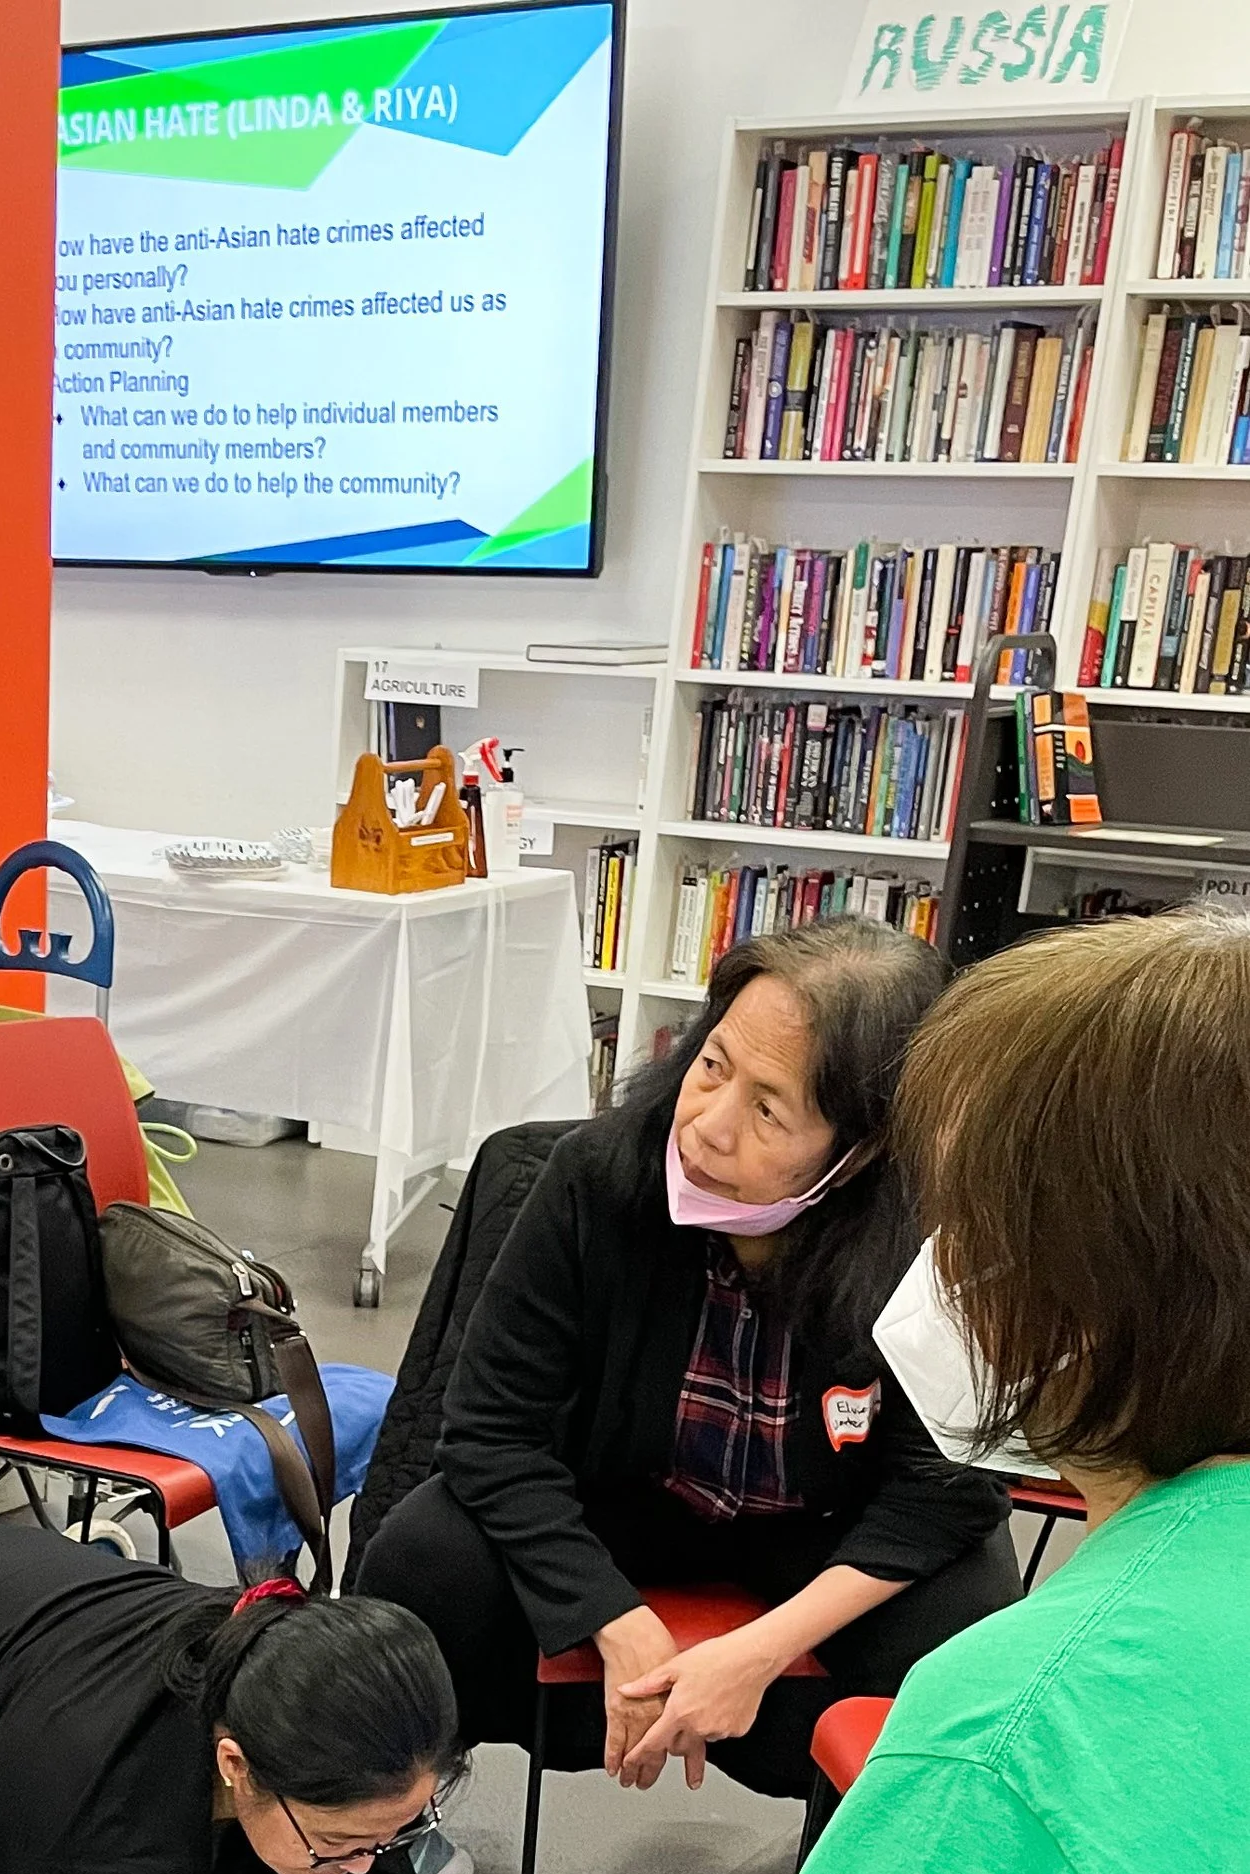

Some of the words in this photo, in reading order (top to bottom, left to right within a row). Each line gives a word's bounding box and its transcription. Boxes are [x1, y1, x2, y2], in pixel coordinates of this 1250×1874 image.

[859, 4, 1110, 95] RUSSIA
[144, 101, 219, 139] HATE
[227, 93, 333, 140] (LINDA
[341, 89, 365, 125] &
[374, 84, 458, 124] RIYA)
[58, 237, 84, 257] ow
[90, 233, 134, 256] have
[140, 231, 169, 252] the
[175, 225, 271, 251] anti-Asian
[276, 223, 320, 246] hate
[326, 219, 394, 244] crimes
[400, 212, 485, 240] affected
[55, 274, 78, 292] ou
[82, 264, 188, 296] personally?
[91, 304, 136, 326] have
[141, 299, 235, 323] anti-Asian
[241, 298, 283, 320] hate
[289, 294, 355, 319] crimes
[361, 290, 444, 316] affected
[450, 294, 475, 312] us
[481, 293, 507, 311] as
[63, 335, 173, 363] community?
[110, 370, 190, 397] Planning
[80, 405, 128, 427] What
[133, 409, 166, 426] can
[171, 410, 198, 426] we
[203, 404, 228, 426] do
[233, 404, 251, 425] to
[256, 403, 297, 429] help
[303, 401, 396, 424] individual
[402, 400, 499, 423] members
[82, 439, 116, 460] and
[121, 438, 220, 465] community
[225, 436, 327, 460] members?
[83, 472, 131, 493] What
[135, 476, 168, 493] can
[172, 477, 200, 493] we
[205, 472, 229, 493] do
[234, 472, 252, 493] to
[257, 471, 298, 498] help
[304, 472, 333, 494] the
[339, 471, 461, 500] community?
[1141, 573, 1161, 636] CAPITAL
[373, 660, 389, 674] 17
[371, 678, 466, 698] AGRICULTURE
